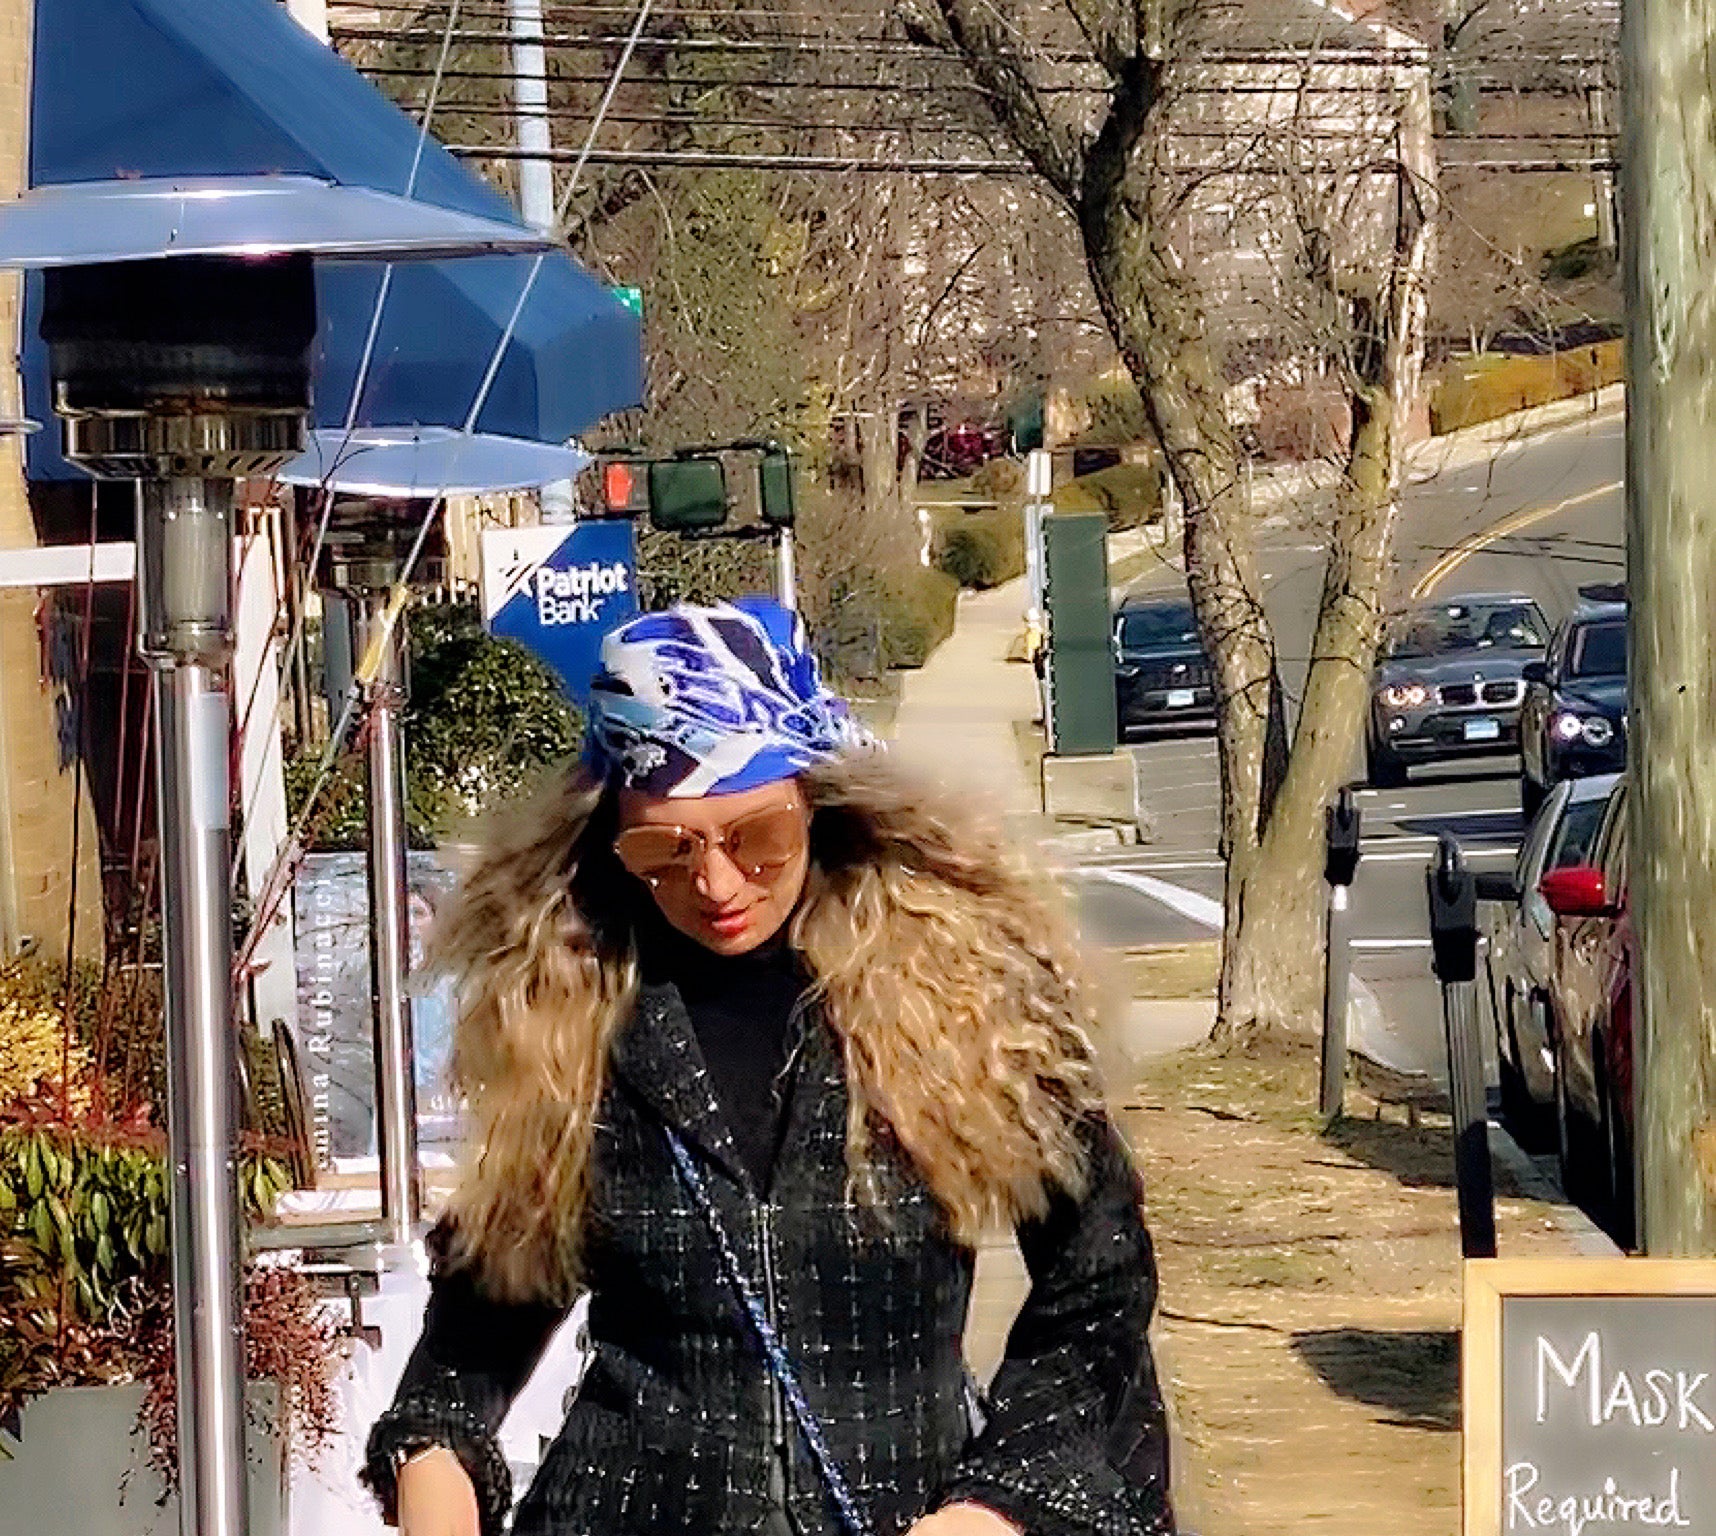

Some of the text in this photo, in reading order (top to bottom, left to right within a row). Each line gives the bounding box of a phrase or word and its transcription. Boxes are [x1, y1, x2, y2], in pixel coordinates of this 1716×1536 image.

[537, 562, 628, 597] Patriot
[538, 597, 605, 625] Bank
[308, 879, 333, 1053] Rubinacci
